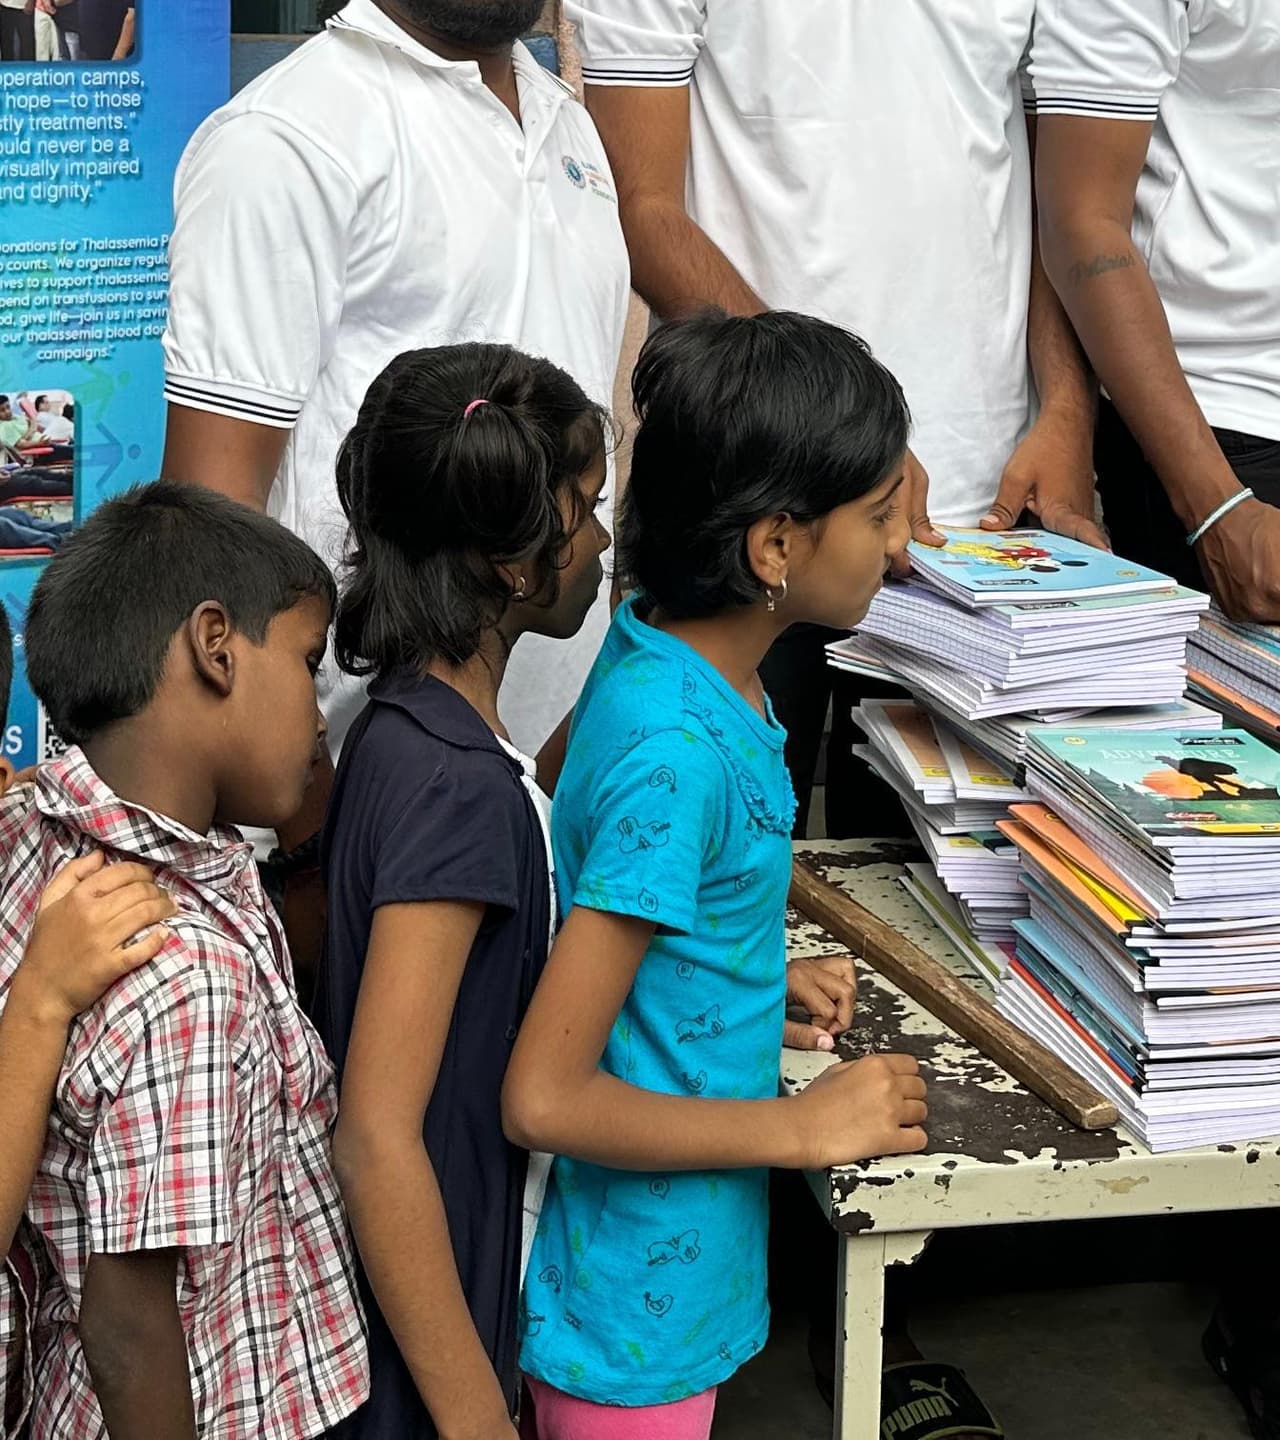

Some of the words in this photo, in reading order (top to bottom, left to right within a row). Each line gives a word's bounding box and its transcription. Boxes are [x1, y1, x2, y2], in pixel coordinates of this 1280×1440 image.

[81, 71, 145, 90] camps,
[95, 91, 142, 109] those
[28, 111, 137, 131] treatments."
[37, 139, 85, 154] never
[91, 136, 114, 153] be
[118, 139, 130, 153] a
[65, 157, 140, 179] impaired
[31, 180, 102, 202] dignity."
[60, 238, 80, 252] for
[82, 236, 159, 251] Thalassemia
[8, 258, 51, 272] counts.
[55, 256, 74, 268] We
[77, 254, 131, 269] organize
[27, 275, 40, 289] to
[43, 273, 93, 290] support
[95, 270, 169, 287] thalassemia
[33, 296, 50, 307] on
[53, 291, 129, 306] transfusions
[131, 290, 144, 302] to
[20, 311, 46, 327] give
[106, 308, 121, 321] us
[123, 307, 135, 320] in
[0, 332, 22, 345] our
[26, 328, 103, 343] thalassemia
[106, 326, 141, 340] blood
[882, 1396, 952, 1440] PUMA
